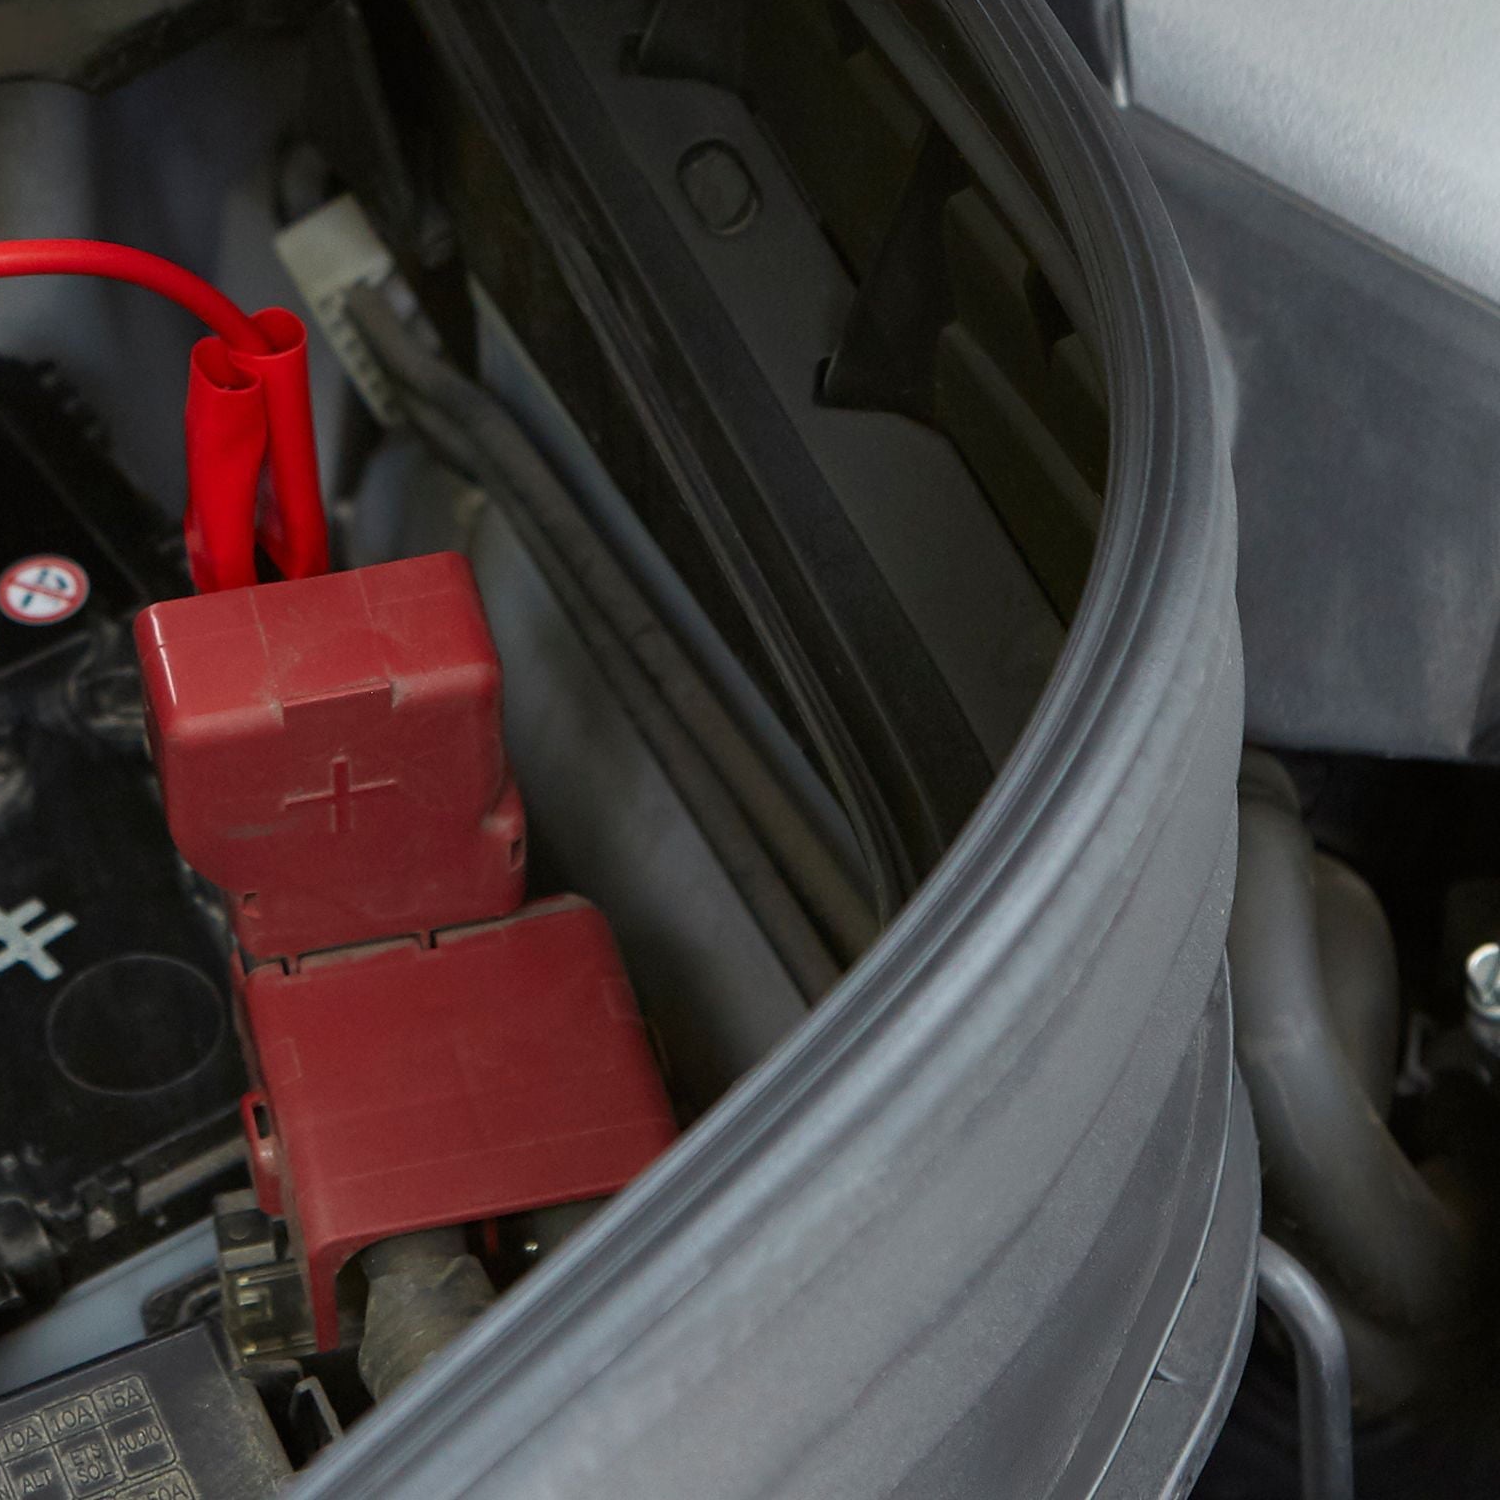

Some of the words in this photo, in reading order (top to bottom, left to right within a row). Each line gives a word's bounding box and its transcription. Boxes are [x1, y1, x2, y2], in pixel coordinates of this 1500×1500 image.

[100, 1385, 144, 1413] 15A
[51, 1405, 95, 1432] 10A
[0, 1425, 43, 1453] 10A
[115, 1424, 163, 1456] AUDIO
[22, 1467, 52, 1494] ALT
[76, 1464, 113, 1485] SOL
